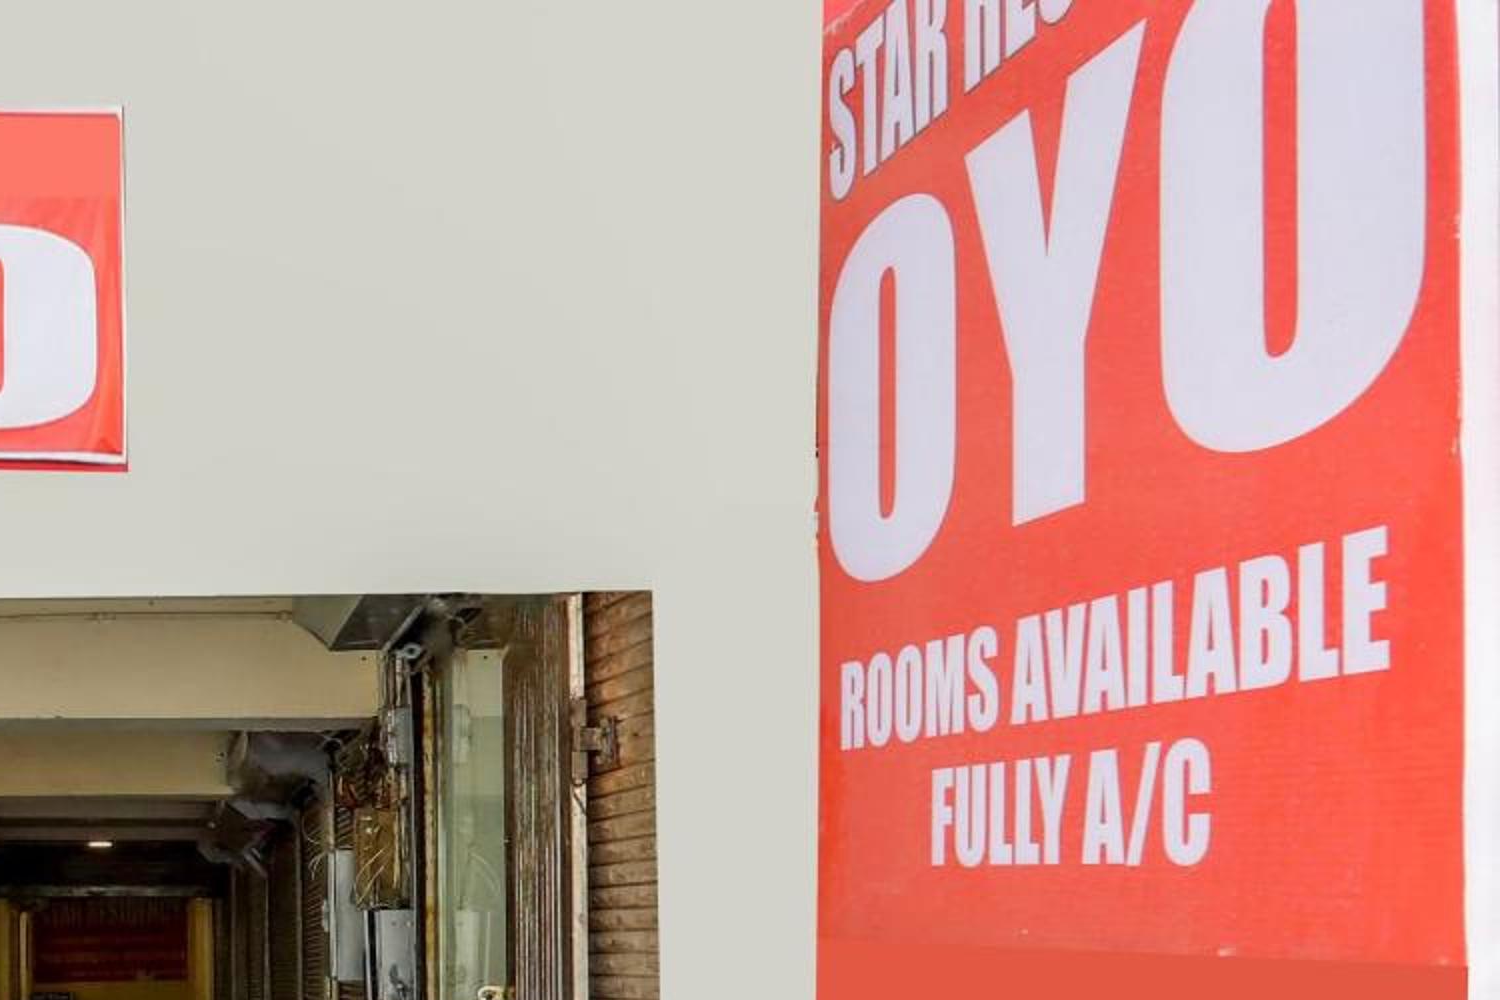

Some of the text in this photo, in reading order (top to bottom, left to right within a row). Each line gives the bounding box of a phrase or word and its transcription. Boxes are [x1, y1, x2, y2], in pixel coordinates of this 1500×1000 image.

[829, 0, 949, 201] STAR
[828, 0, 1426, 582] OYO
[840, 525, 1391, 752] ROOMS AVAILABLE
[931, 737, 1211, 868] FULLY A/C
